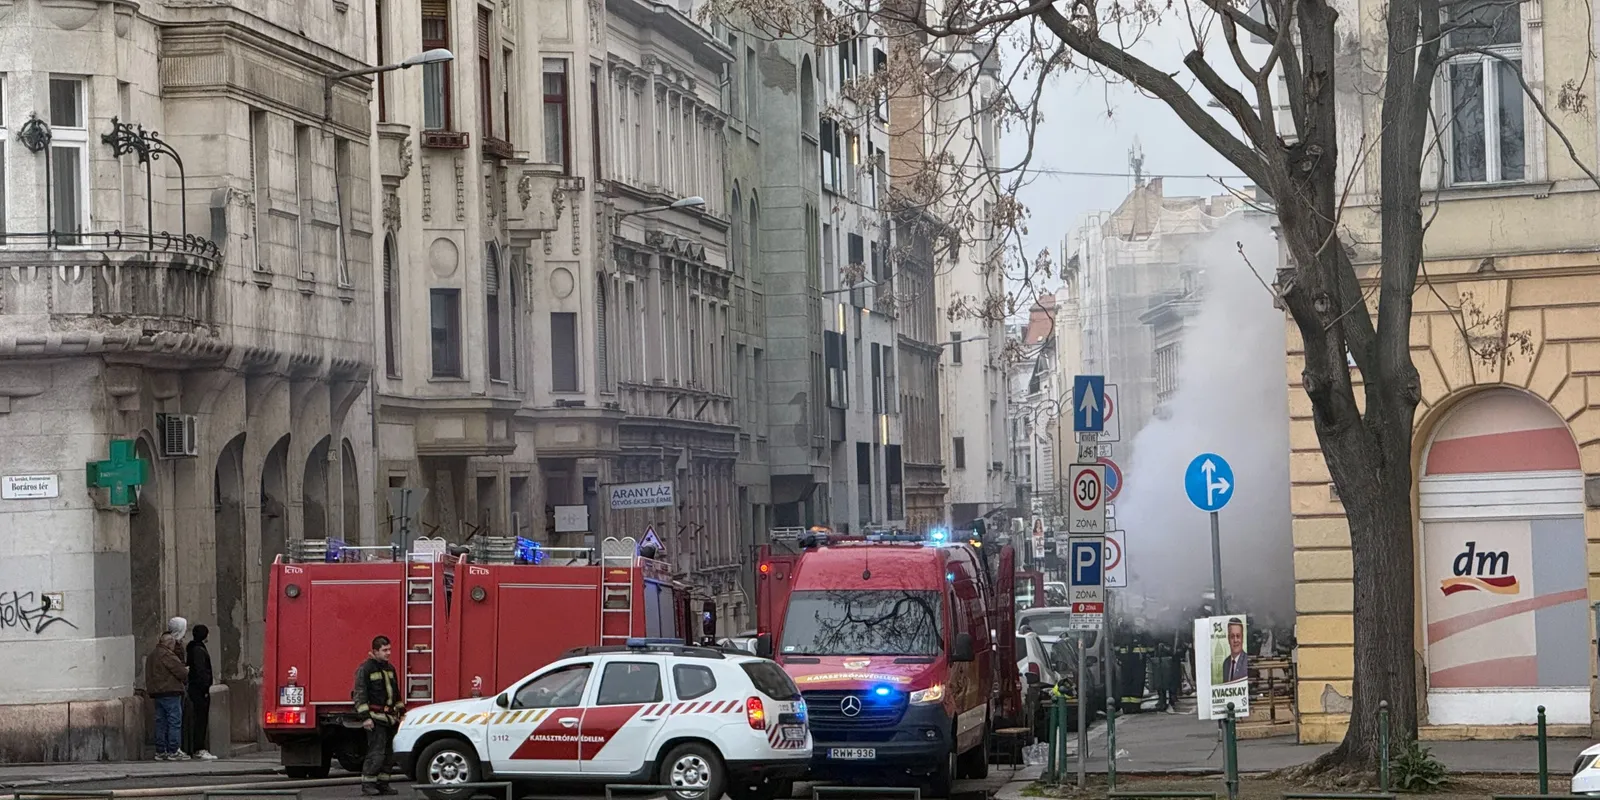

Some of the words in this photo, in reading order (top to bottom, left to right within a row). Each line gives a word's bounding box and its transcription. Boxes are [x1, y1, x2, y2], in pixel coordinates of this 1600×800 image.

[12, 482, 37, 490] Boráros
[39, 482, 48, 490] tér
[1079, 480, 1096, 500] 30
[612, 485, 671, 499] ARANYLÁZ
[1076, 518, 1098, 528] ZÓNA
[1453, 542, 1508, 576] dm
[1076, 590, 1097, 599] ZÓNA
[1212, 686, 1246, 698] KVACSKAY
[286, 696, 302, 704] 559
[530, 734, 604, 742] KATASZTRÓFAVÉDELEM
[832, 748, 874, 758] RWW-936
